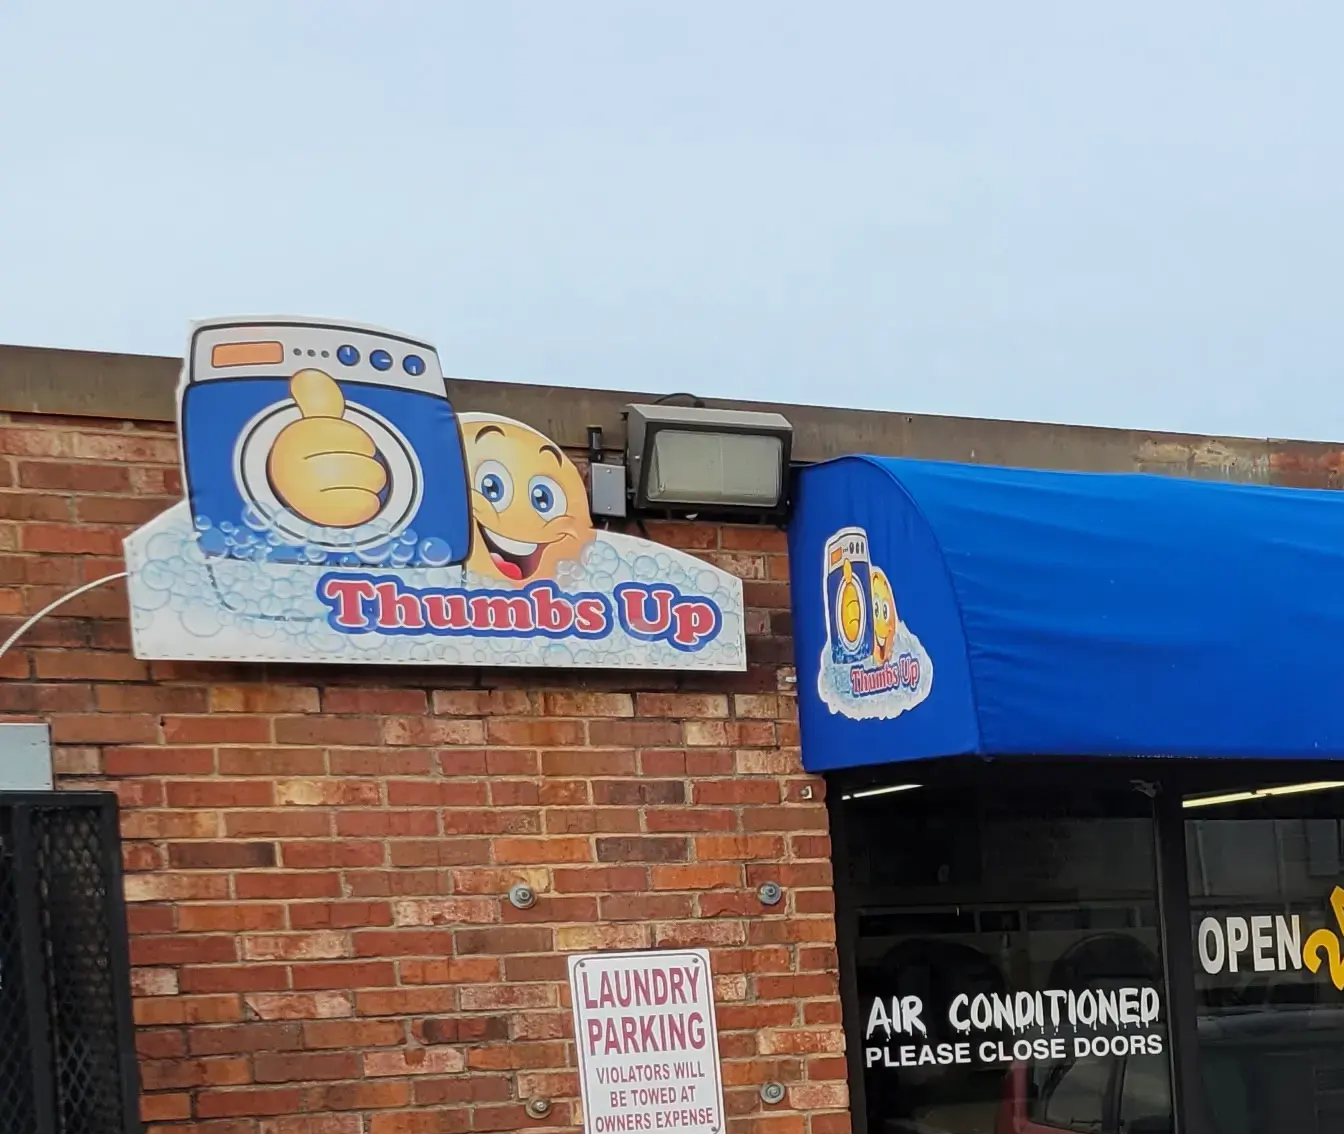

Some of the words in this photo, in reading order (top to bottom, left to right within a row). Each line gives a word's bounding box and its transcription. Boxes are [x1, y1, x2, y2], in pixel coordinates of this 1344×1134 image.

[326, 580, 606, 633] Thumbs
[621, 589, 715, 645] Up
[852, 664, 899, 693] Thumbs
[899, 658, 919, 690] Up
[1198, 914, 1302, 974] OPEN
[582, 966, 700, 1009] LAUNDRY
[588, 1012, 706, 1056] PARKING
[866, 995, 927, 1042] AIR
[949, 987, 1159, 1035] CONDITIONED
[866, 1043, 971, 1068] PLEASE
[979, 1039, 1066, 1062] CLOSE
[1074, 1035, 1163, 1058] DOORS
[596, 1063, 670, 1085] VIOLATORS
[673, 1061, 705, 1079] WILL
[610, 1091, 627, 1108] BE
[631, 1087, 676, 1106] TOWED
[681, 1086, 696, 1102] AT
[595, 1112, 651, 1133] OWNERS
[656, 1108, 713, 1128] EXPENSE
